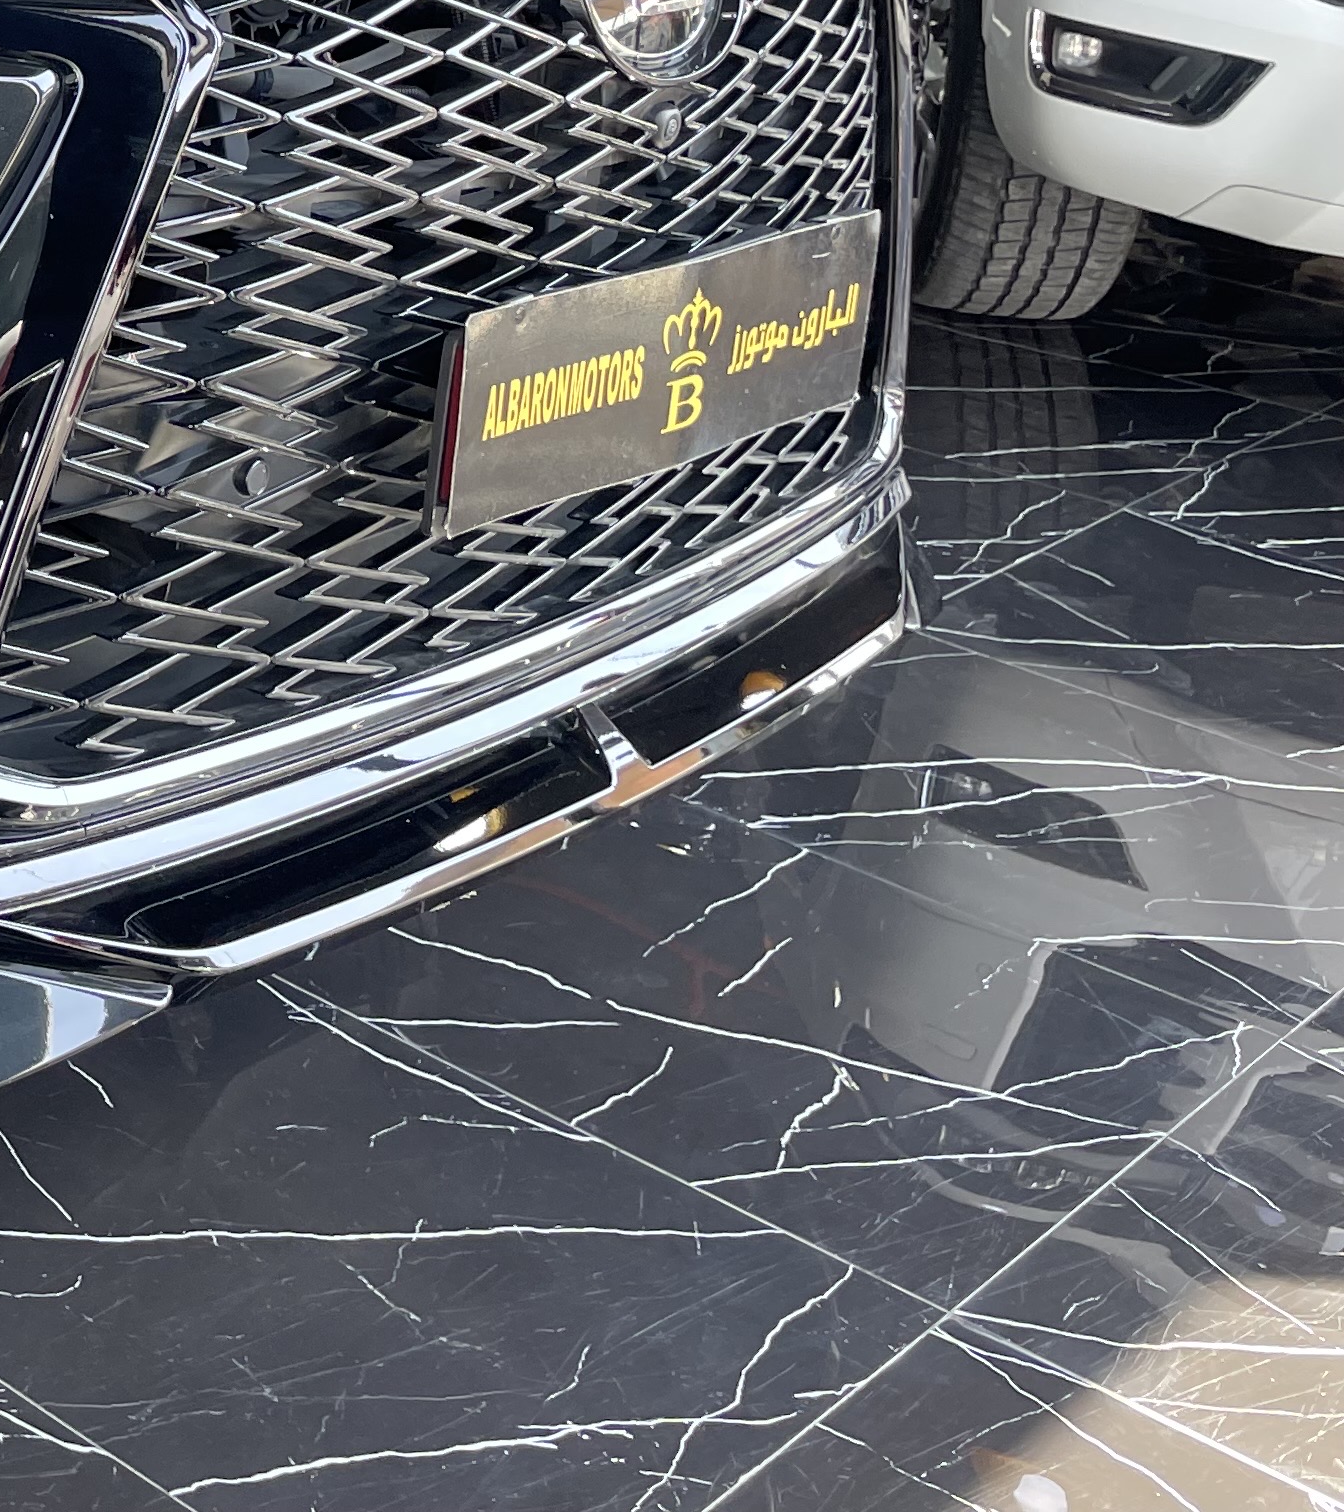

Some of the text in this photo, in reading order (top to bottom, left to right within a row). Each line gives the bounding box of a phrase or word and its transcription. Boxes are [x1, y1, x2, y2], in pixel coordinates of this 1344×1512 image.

[726, 282, 860, 375] البارون موتورز
[660, 374, 705, 434] B
